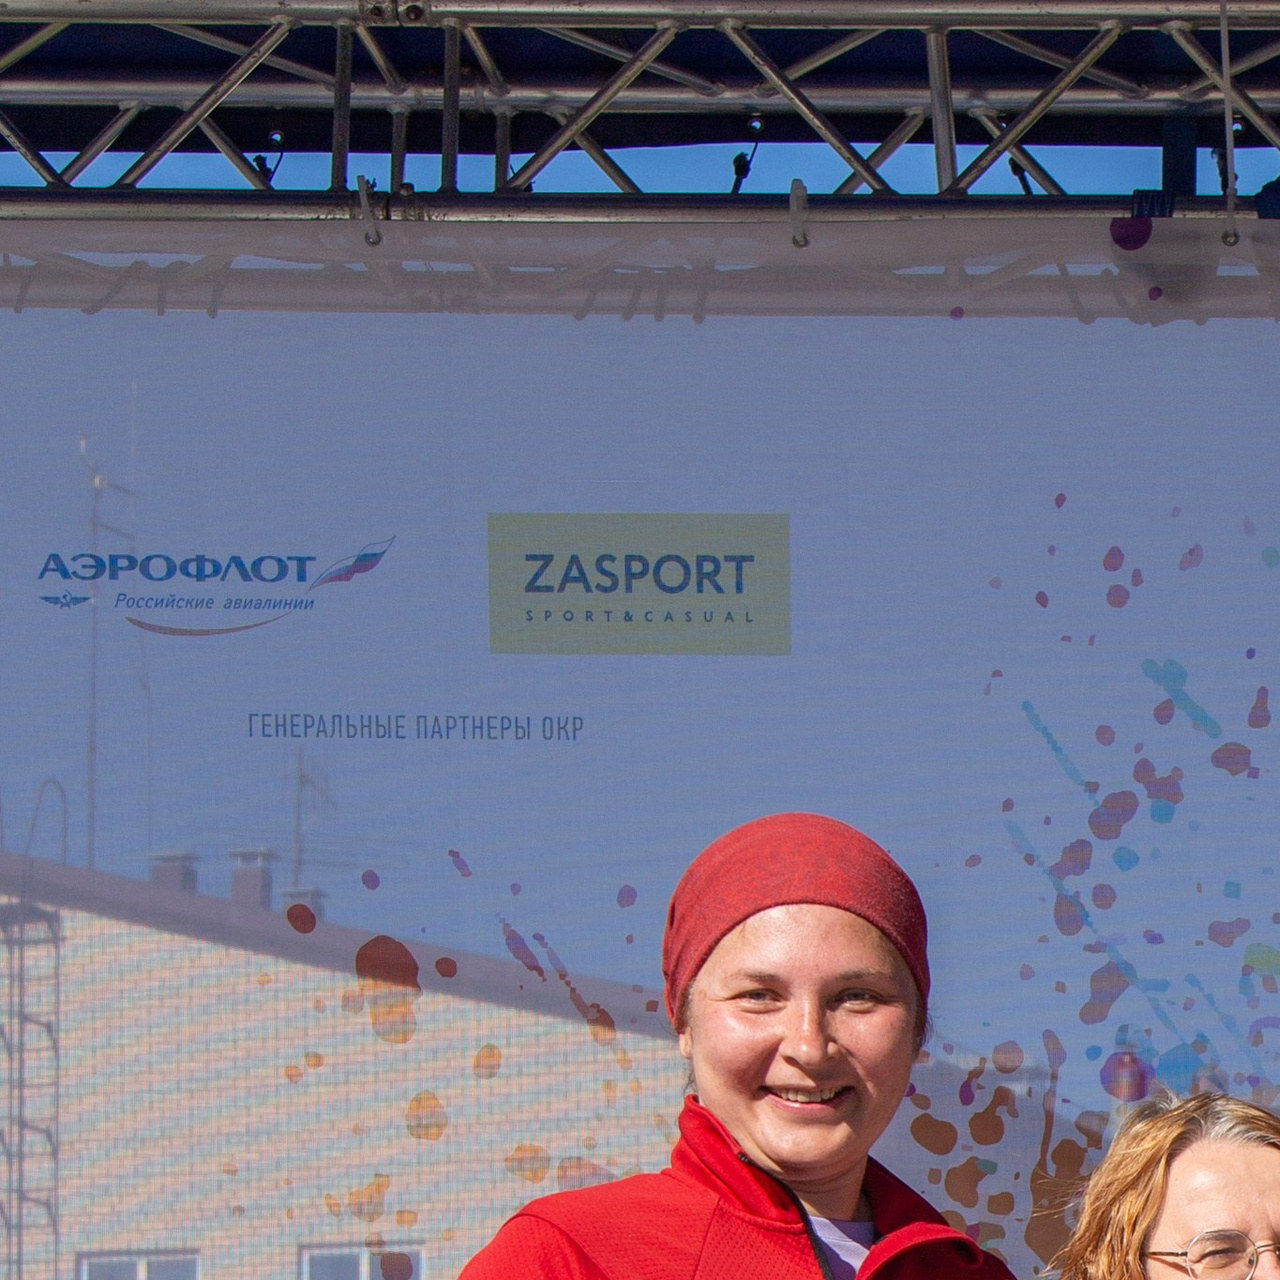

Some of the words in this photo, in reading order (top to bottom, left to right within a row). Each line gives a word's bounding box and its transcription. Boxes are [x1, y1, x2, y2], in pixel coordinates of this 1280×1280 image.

[38, 553, 316, 582] АЭРОФЛОТ
[524, 554, 755, 594] ZASPORT
[114, 592, 215, 610] Российские
[223, 597, 315, 611] авиалинии
[248, 713, 407, 739] ГЕНЕРАЛЬНЫЕ
[416, 715, 531, 741] ПАРТНЕРЫ
[542, 716, 584, 741] ОКР
